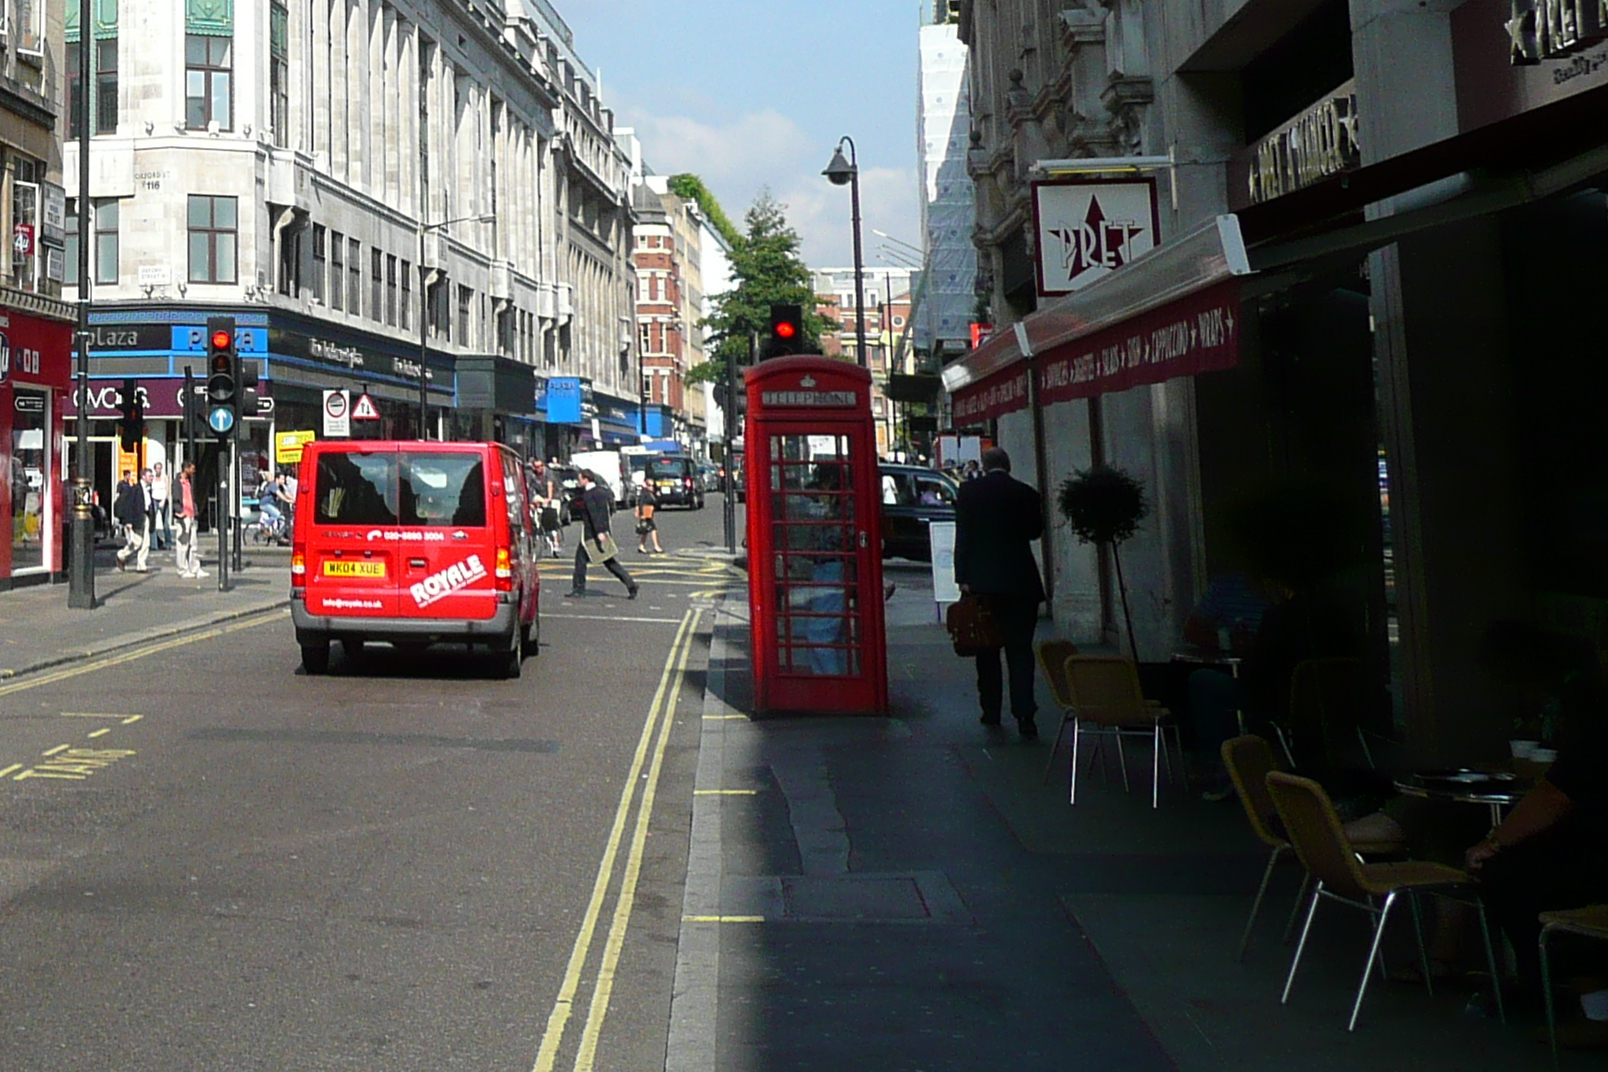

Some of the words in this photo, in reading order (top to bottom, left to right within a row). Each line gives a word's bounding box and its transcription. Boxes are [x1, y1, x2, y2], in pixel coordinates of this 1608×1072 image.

[1059, 220, 1135, 268] PRET
[765, 391, 852, 404] TELEPHONE
[329, 562, 356, 573] WK04
[359, 563, 380, 575] XUE
[410, 554, 485, 603] ROYALE
